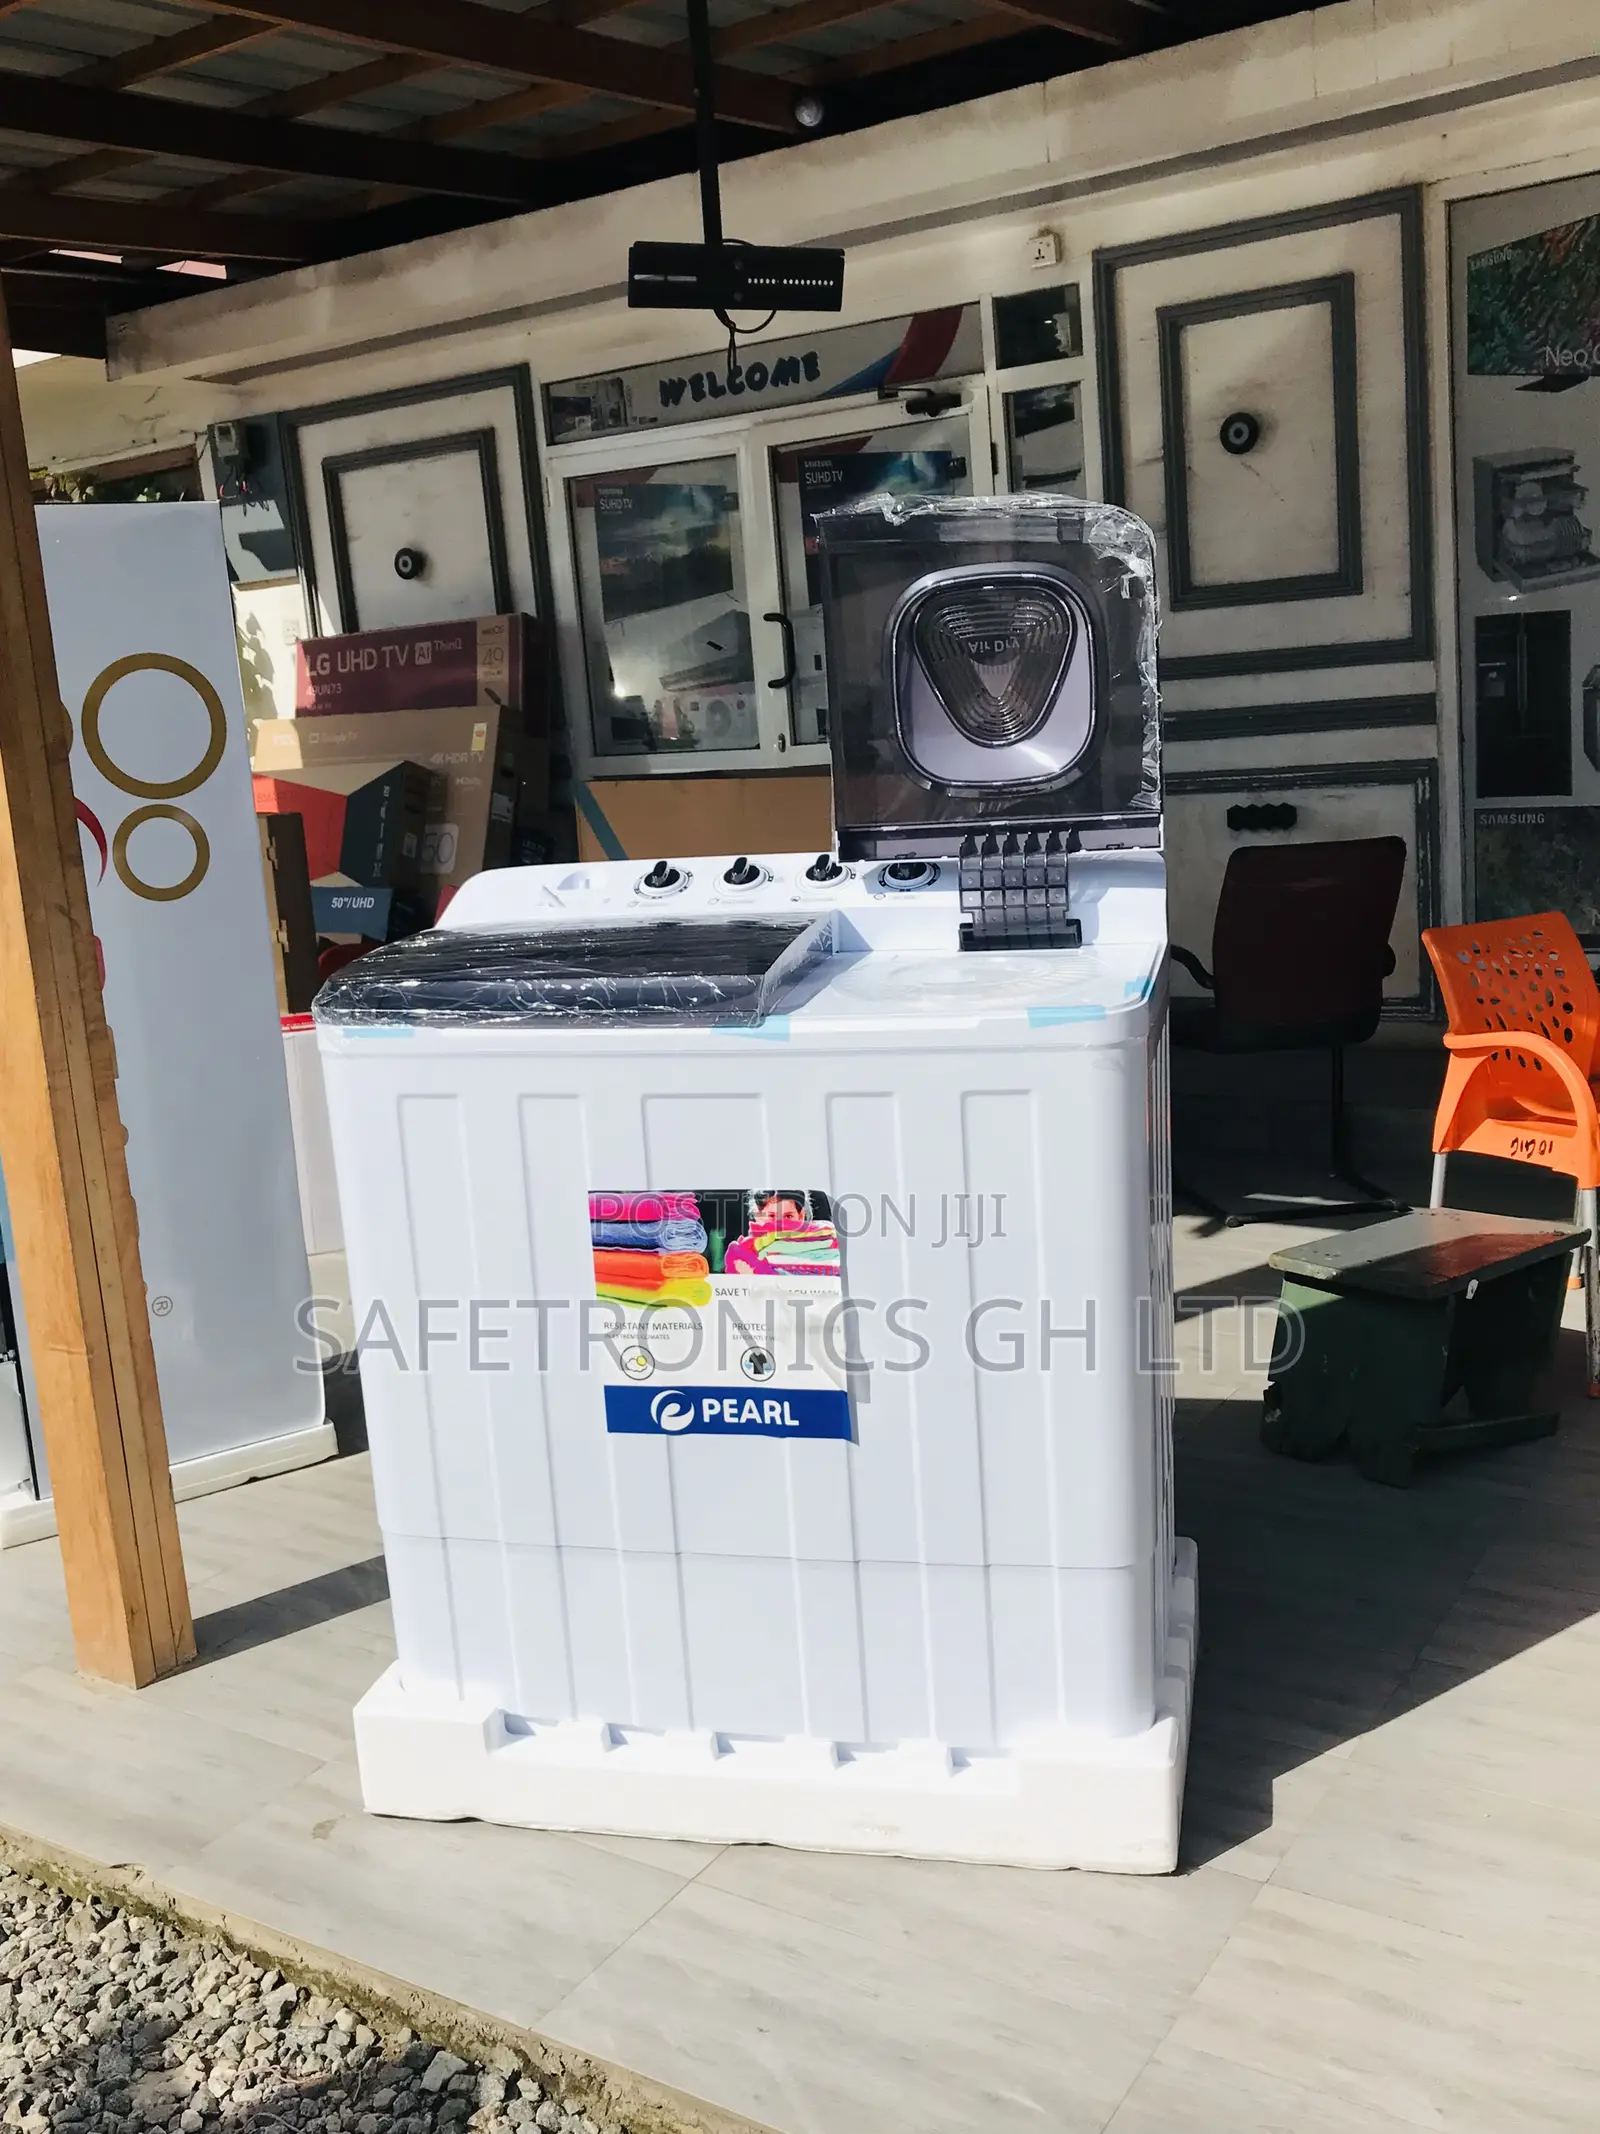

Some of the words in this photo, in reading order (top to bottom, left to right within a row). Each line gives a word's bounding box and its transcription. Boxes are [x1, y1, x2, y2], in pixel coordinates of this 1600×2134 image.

[1545, 346, 1589, 368] Neo
[659, 351, 820, 407] WELCOME
[805, 472, 831, 485] SUHD
[831, 471, 843, 482] TV
[306, 653, 331, 677] LG
[337, 648, 378, 673] UHD
[381, 645, 409, 668] TV
[416, 643, 431, 664] AI
[482, 647, 504, 669] 49
[1479, 813, 1545, 825] SAMSUNG
[421, 832, 455, 864] 50
[331, 897, 375, 909] 50"/UHD
[715, 1288, 739, 1297] SAVE
[604, 1321, 650, 1331] RESISTANT
[652, 1321, 703, 1331] MATERIALS
[702, 1398, 800, 1427] PEARL
